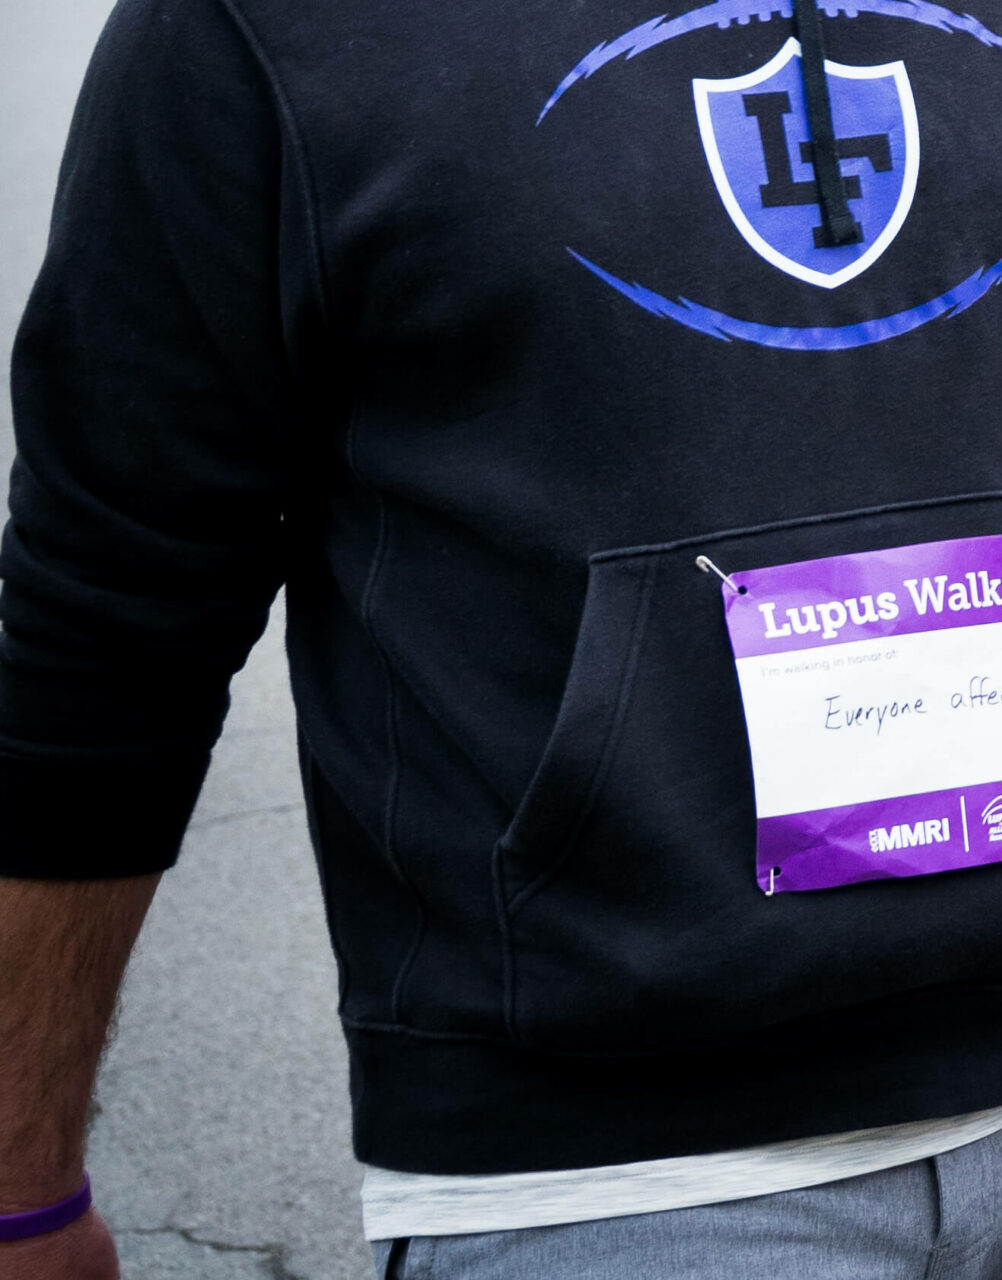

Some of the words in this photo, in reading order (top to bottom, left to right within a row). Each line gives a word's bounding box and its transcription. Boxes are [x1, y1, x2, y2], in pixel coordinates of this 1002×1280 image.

[758, 591, 900, 640] Lupus
[784, 659, 830, 674] walking
[832, 657, 844, 667] in
[847, 652, 882, 665] honor
[824, 694, 929, 735] Everyone
[878, 817, 950, 852] MMRI
